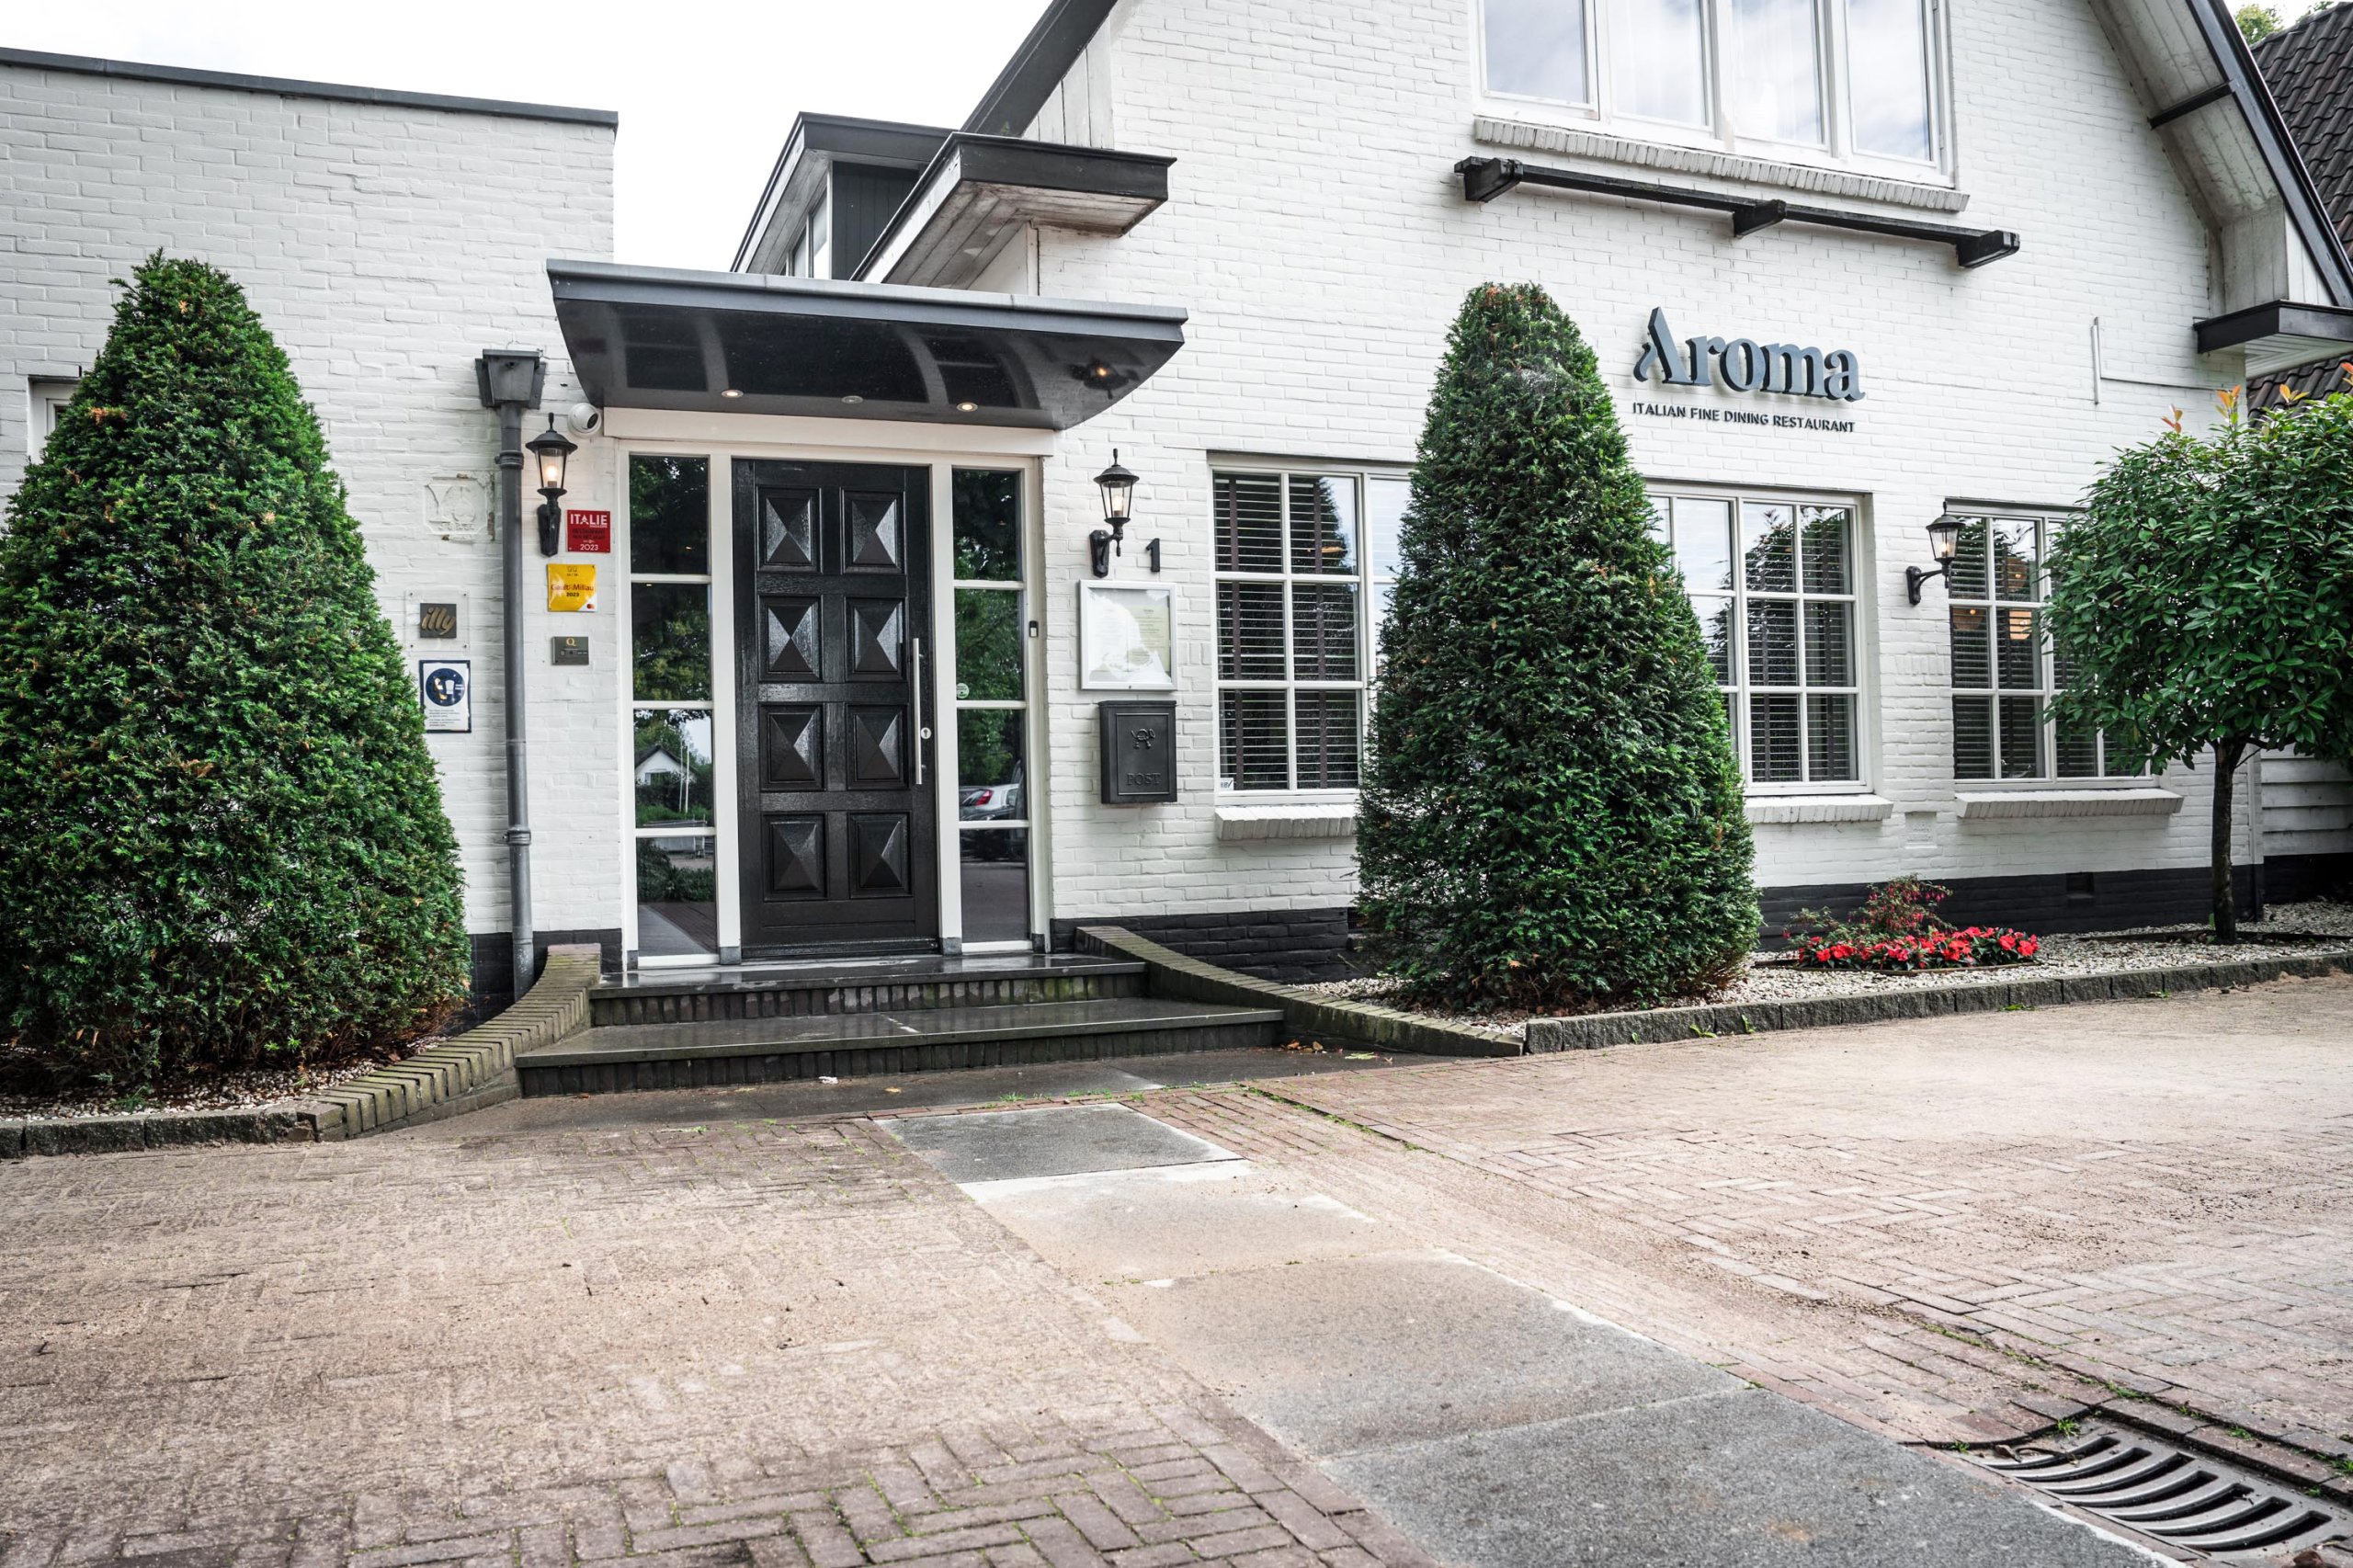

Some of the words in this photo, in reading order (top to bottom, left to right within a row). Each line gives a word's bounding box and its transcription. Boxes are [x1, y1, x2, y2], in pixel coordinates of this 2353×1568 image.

[1632, 306, 1866, 403] Aroma
[1632, 402, 1686, 419] ITALIAN
[1689, 407, 1720, 423] FINE
[1723, 411, 1768, 426] DINING
[1772, 415, 1855, 433] RESTAURANT
[570, 514, 608, 525] ITALIE
[1145, 538, 1160, 573] 1
[421, 607, 456, 635] illy
[1127, 772, 1161, 786] POST
